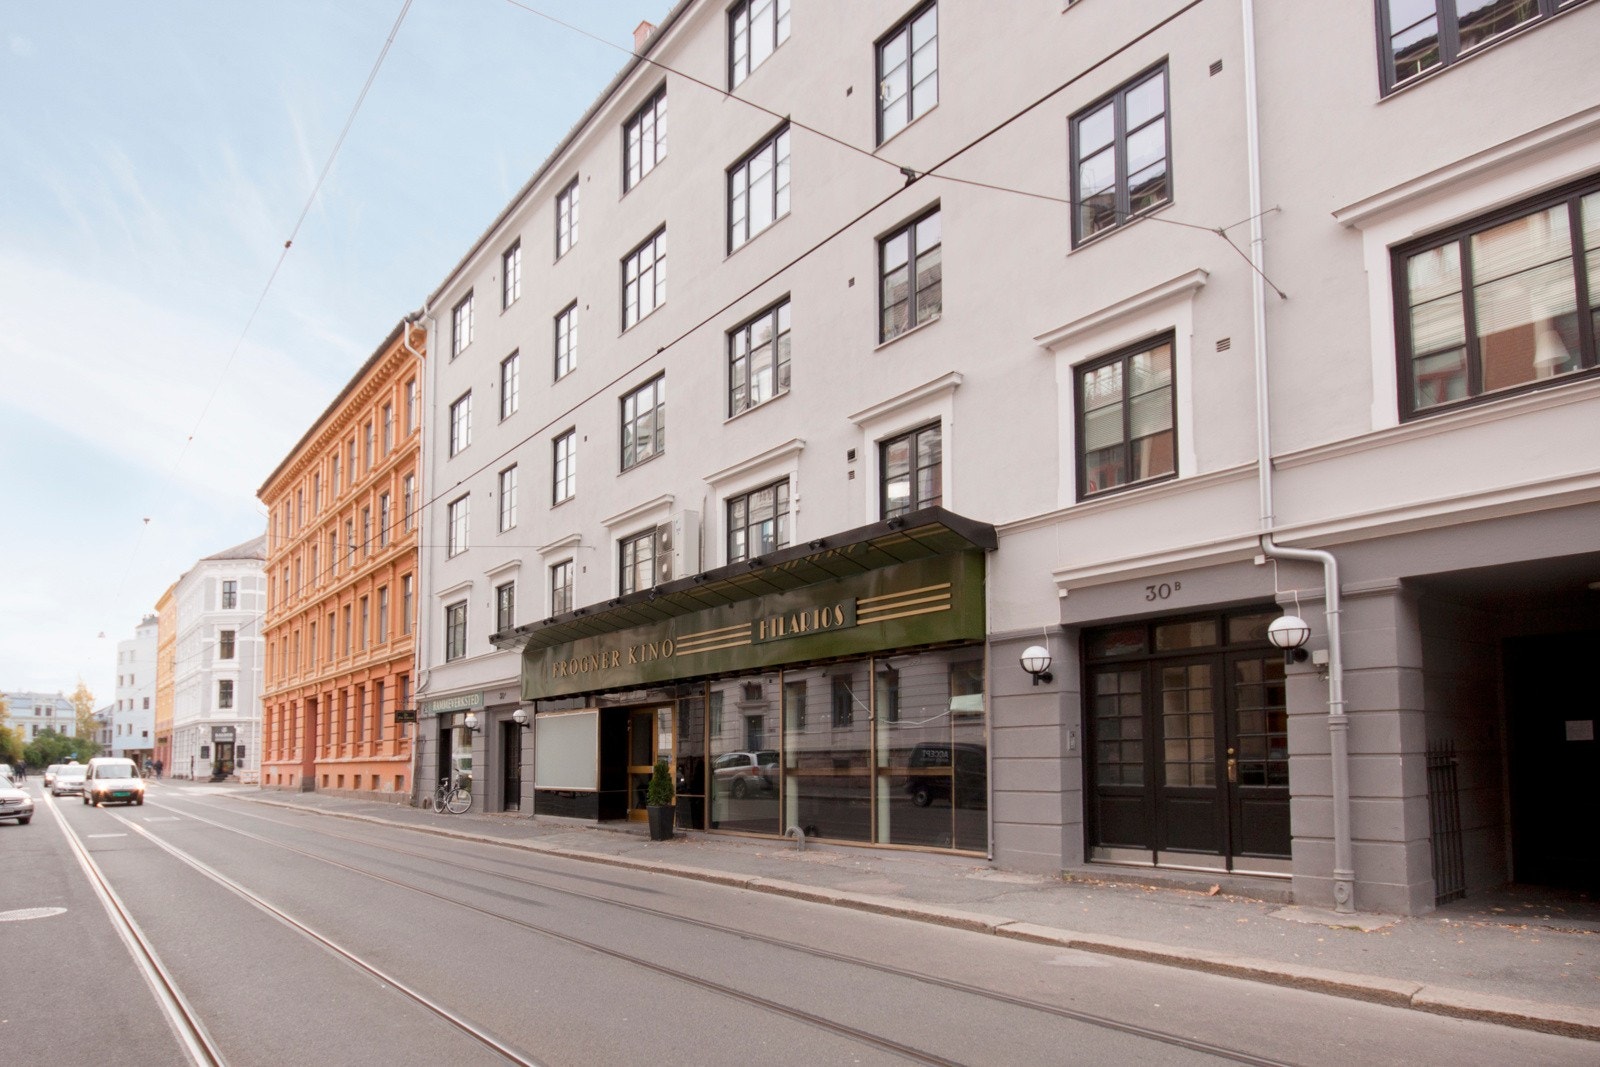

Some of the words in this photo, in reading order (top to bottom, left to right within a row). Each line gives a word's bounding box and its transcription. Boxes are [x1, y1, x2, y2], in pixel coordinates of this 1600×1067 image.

[759, 604, 845, 640] HILARIOS
[552, 650, 622, 679] FROGNER
[628, 638, 674, 665] KINO
